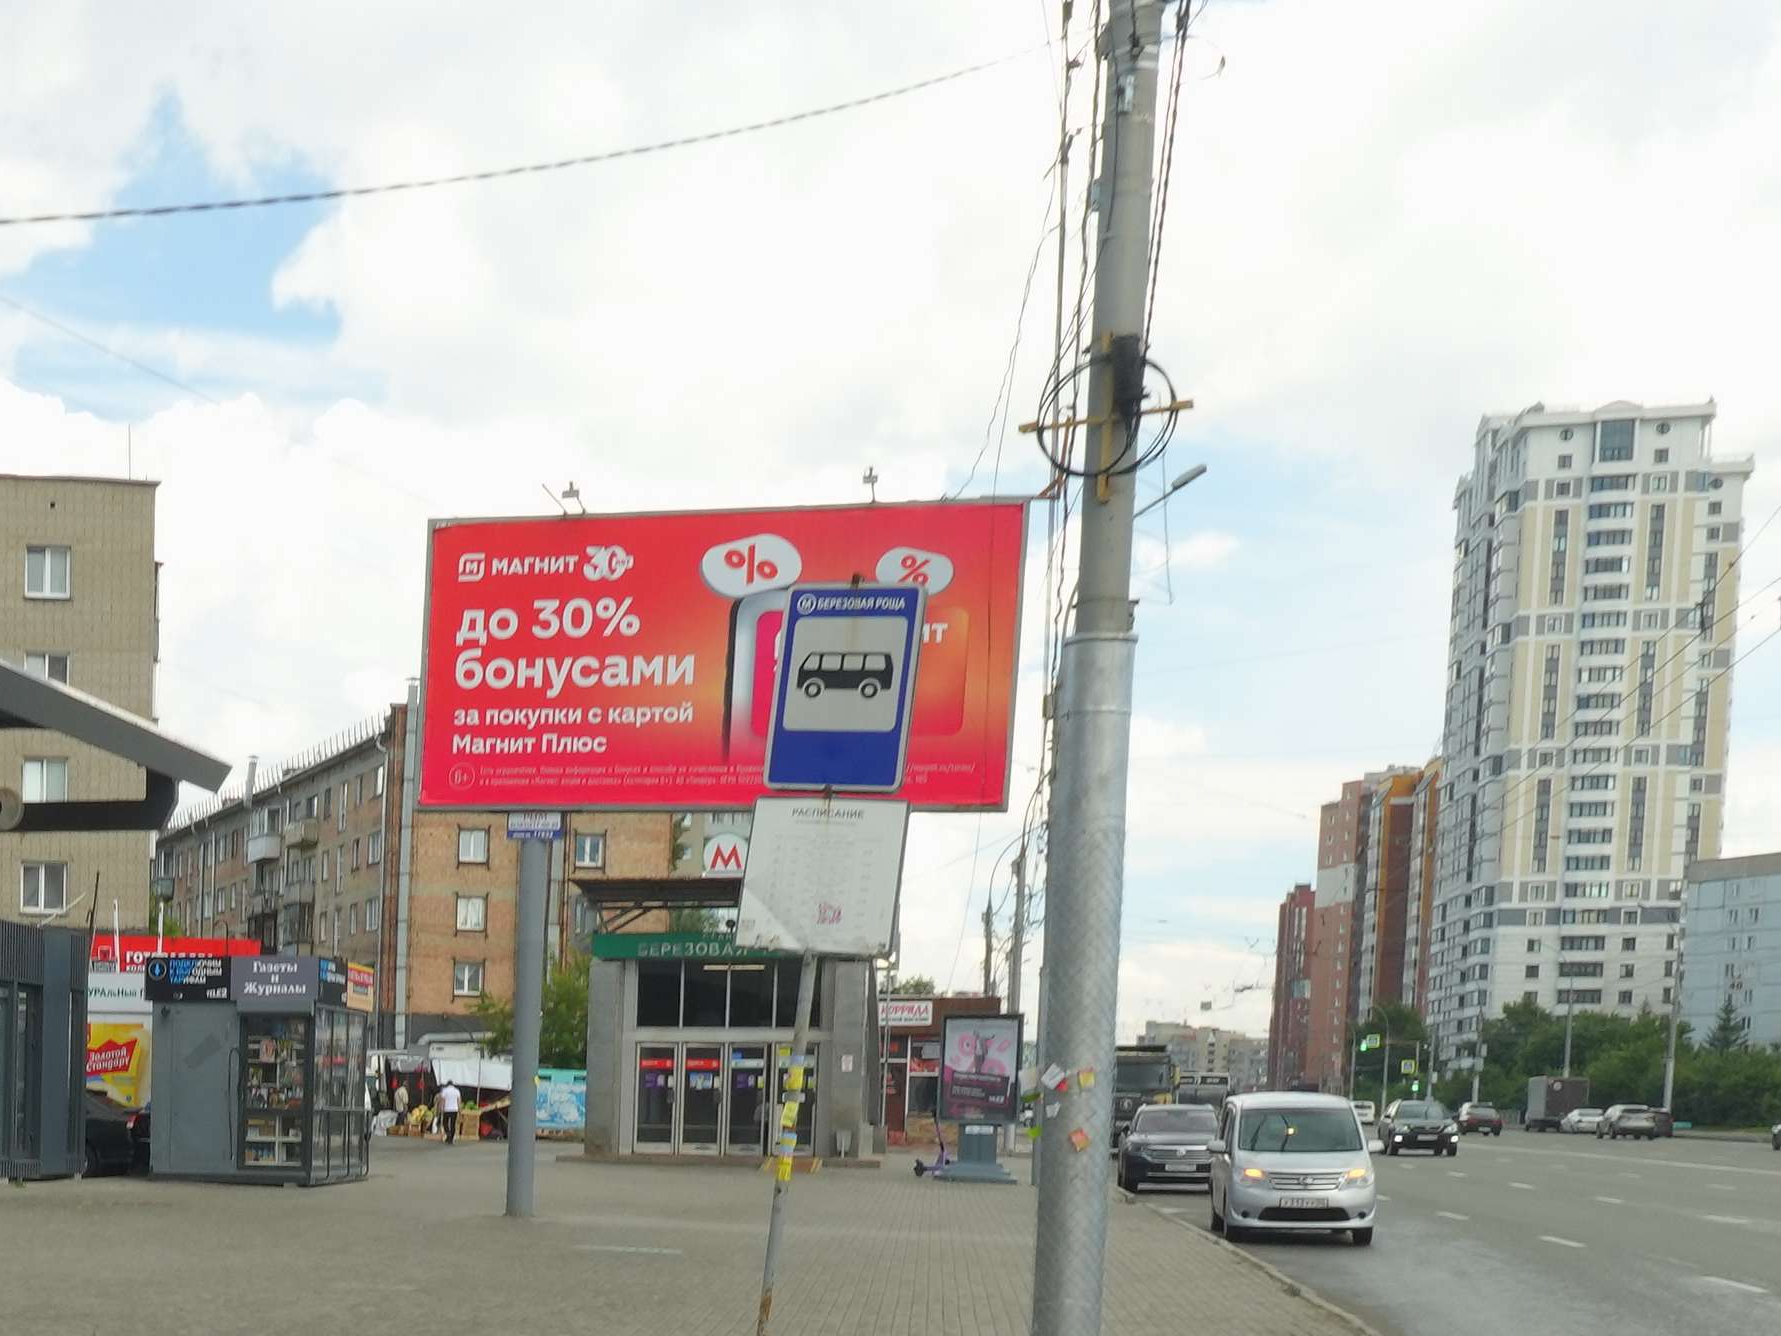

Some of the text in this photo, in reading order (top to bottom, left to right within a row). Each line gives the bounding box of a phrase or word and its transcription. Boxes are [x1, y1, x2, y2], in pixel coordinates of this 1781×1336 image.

[491, 554, 579, 576] МАГНИТ
[817, 597, 874, 611] БЕРЕЗОВАЯ
[875, 597, 906, 612] РОЩА
[455, 597, 640, 647] до 30%
[455, 648, 695, 699] бонусами
[454, 702, 694, 730] за покупки с картой
[452, 732, 608, 755] Магнит Плюс
[792, 808, 865, 819] РАСПИСАНИЕ
[710, 843, 742, 869] М
[252, 961, 298, 973] Газеты
[170, 976, 207, 984] ТАРИФАМ
[243, 982, 307, 996] Журналы
